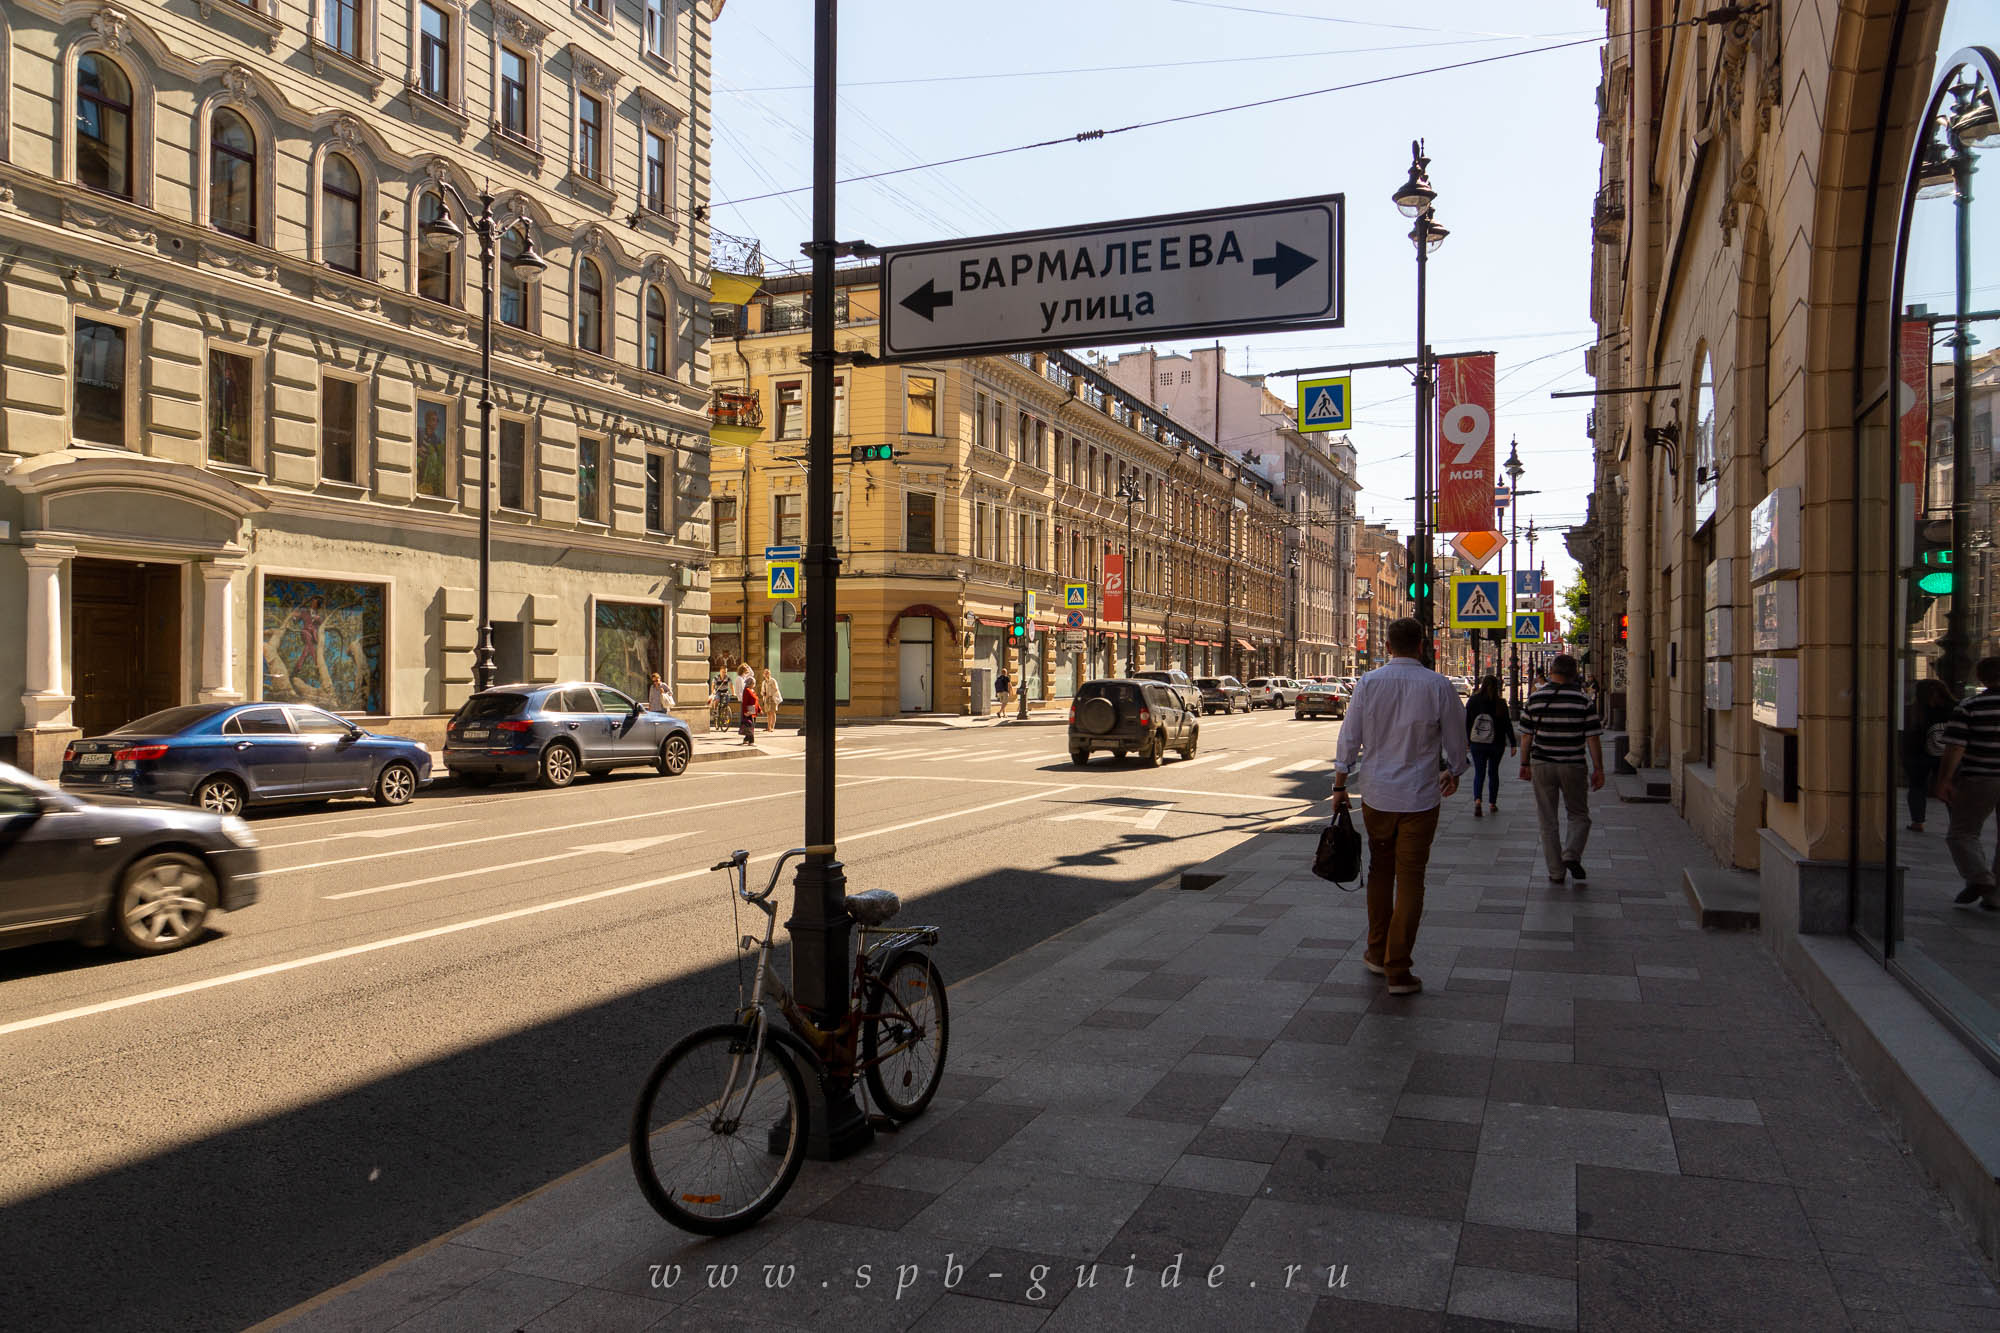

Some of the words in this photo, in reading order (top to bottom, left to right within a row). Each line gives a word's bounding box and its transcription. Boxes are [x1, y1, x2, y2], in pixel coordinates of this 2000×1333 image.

[959, 230, 1245, 292] БАРМАЛЕЕВА
[1039, 290, 1155, 334] улица
[1442, 403, 1490, 465] 9
[1449, 469, 1484, 481] мая
[1105, 571, 1122, 591] 75
